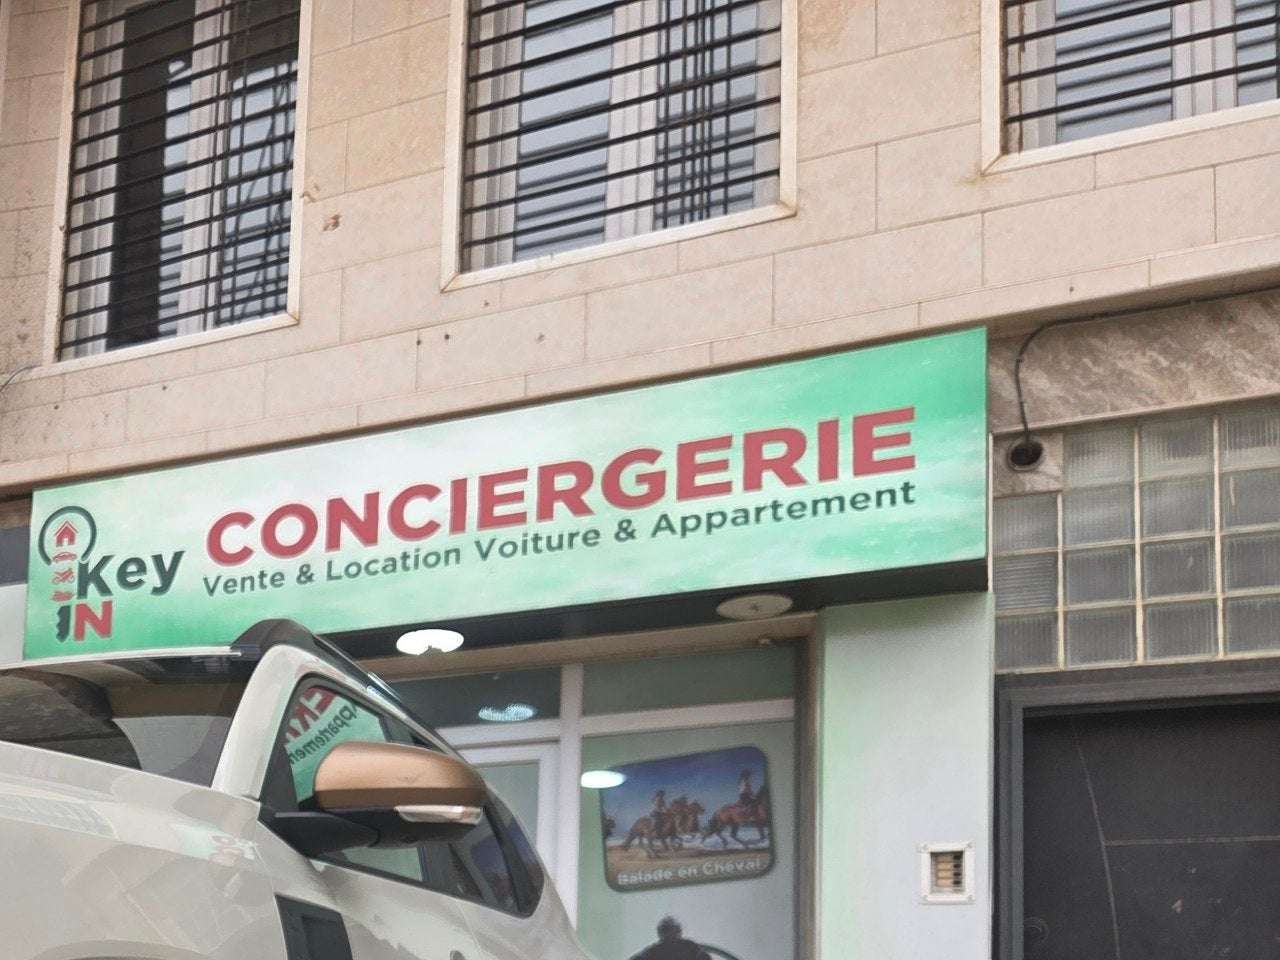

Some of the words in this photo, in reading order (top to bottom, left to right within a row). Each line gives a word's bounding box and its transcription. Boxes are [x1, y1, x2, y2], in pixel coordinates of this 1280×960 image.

[206, 406, 916, 567] CONCIERGERIE
[76, 550, 186, 600] Key
[202, 568, 286, 598] Vente
[296, 564, 316, 583] &
[326, 545, 462, 582] Location
[475, 526, 601, 563] Voiture
[613, 518, 638, 544] &
[652, 480, 916, 540] Appartement
[55, 600, 114, 643] IN
